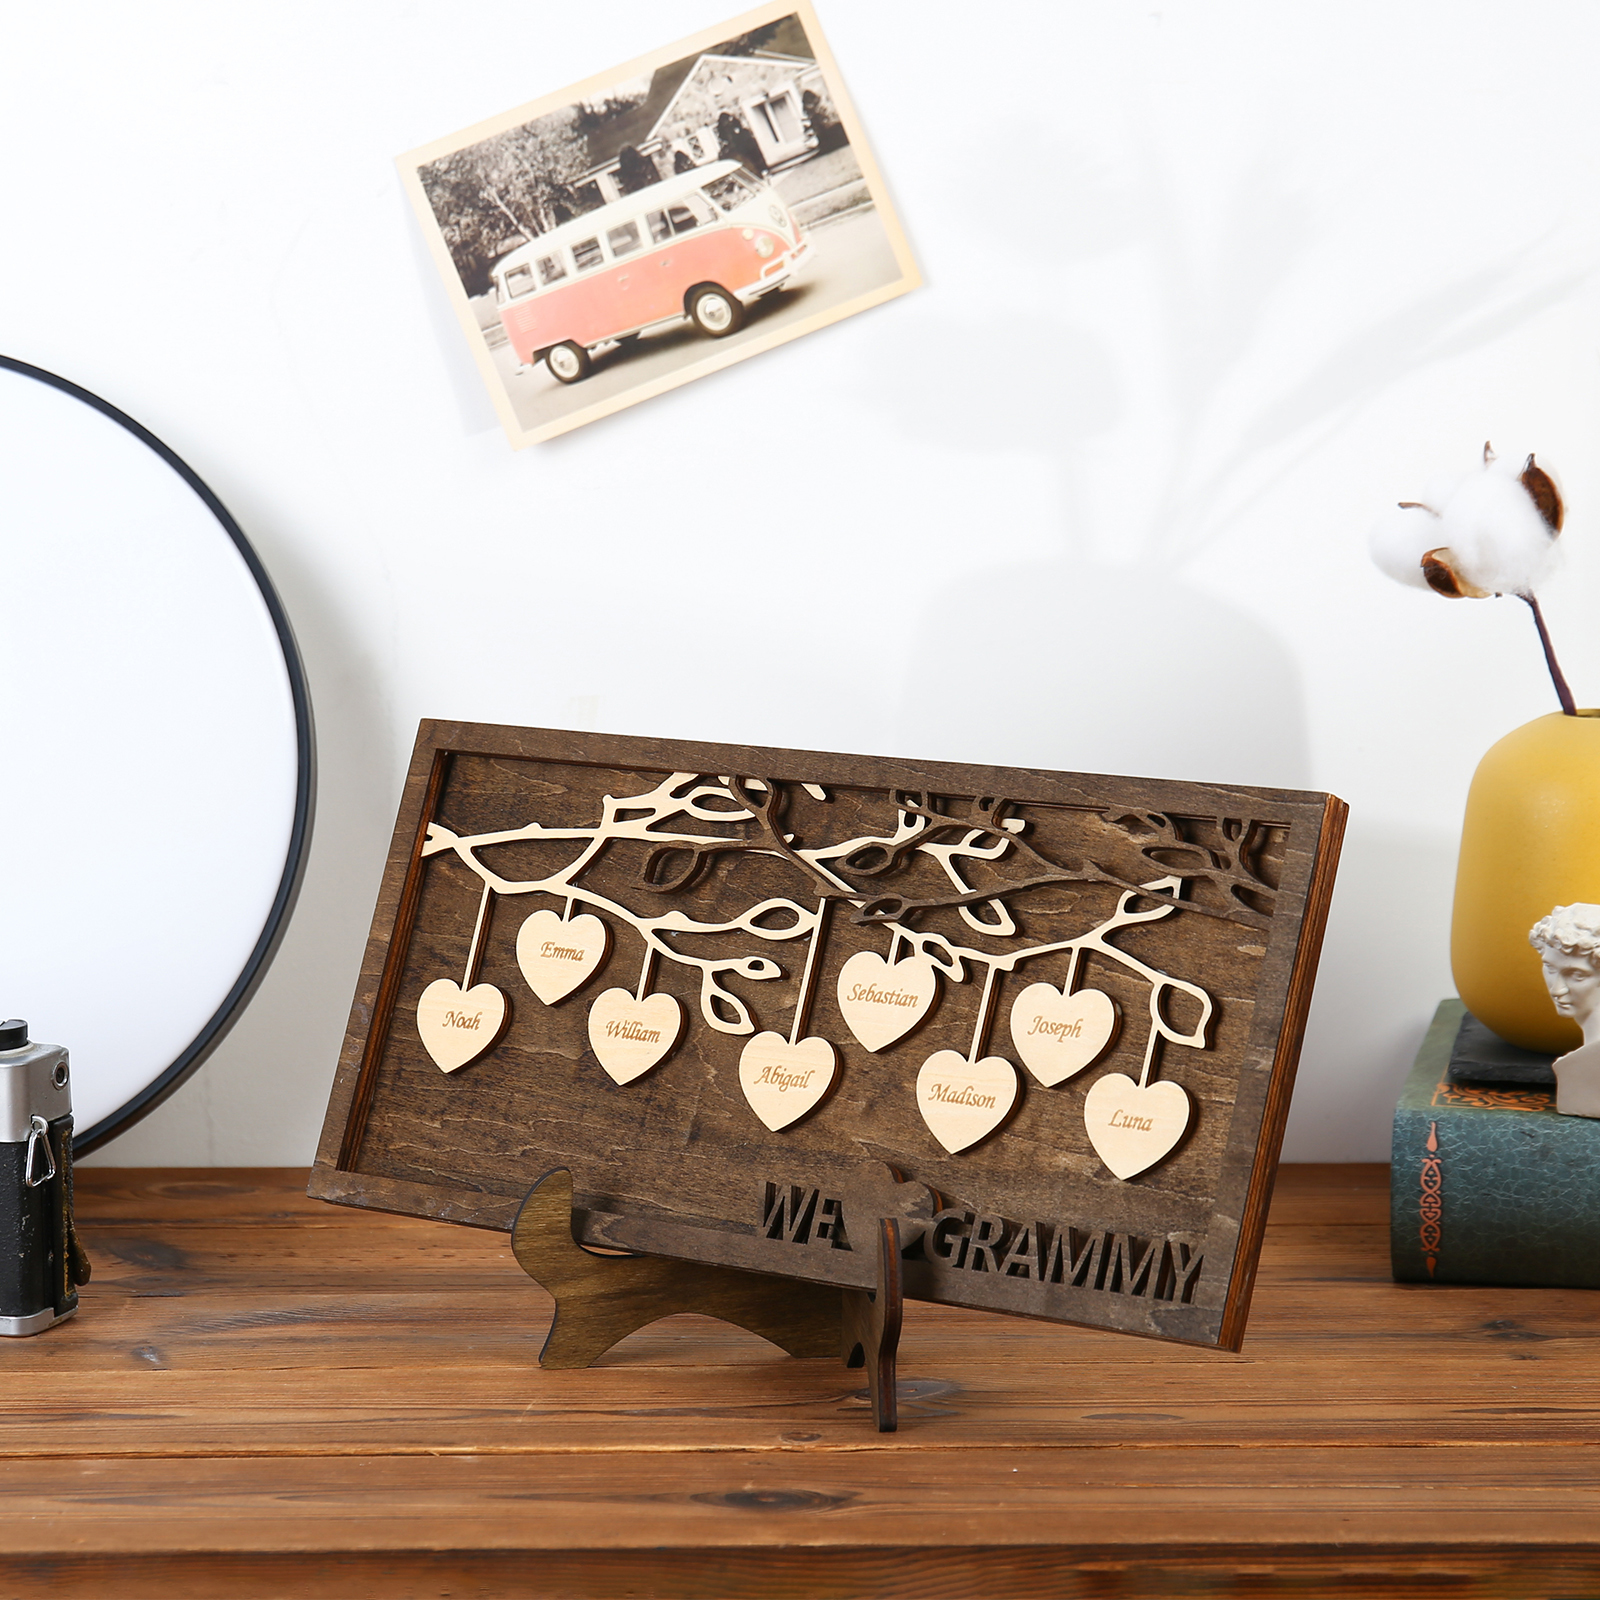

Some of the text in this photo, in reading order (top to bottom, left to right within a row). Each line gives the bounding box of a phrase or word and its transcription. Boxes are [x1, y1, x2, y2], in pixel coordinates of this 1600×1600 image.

[541, 942, 585, 962] Emma
[846, 982, 919, 1009] Sebastian
[442, 1010, 482, 1031] Noah
[605, 1019, 661, 1044] William
[1027, 1015, 1083, 1043] Joseph
[753, 1064, 815, 1092] Abigail
[927, 1083, 997, 1110] Madison
[1107, 1108, 1154, 1132] Luna
[757, 1180, 1206, 1303] WE GRAMMY
